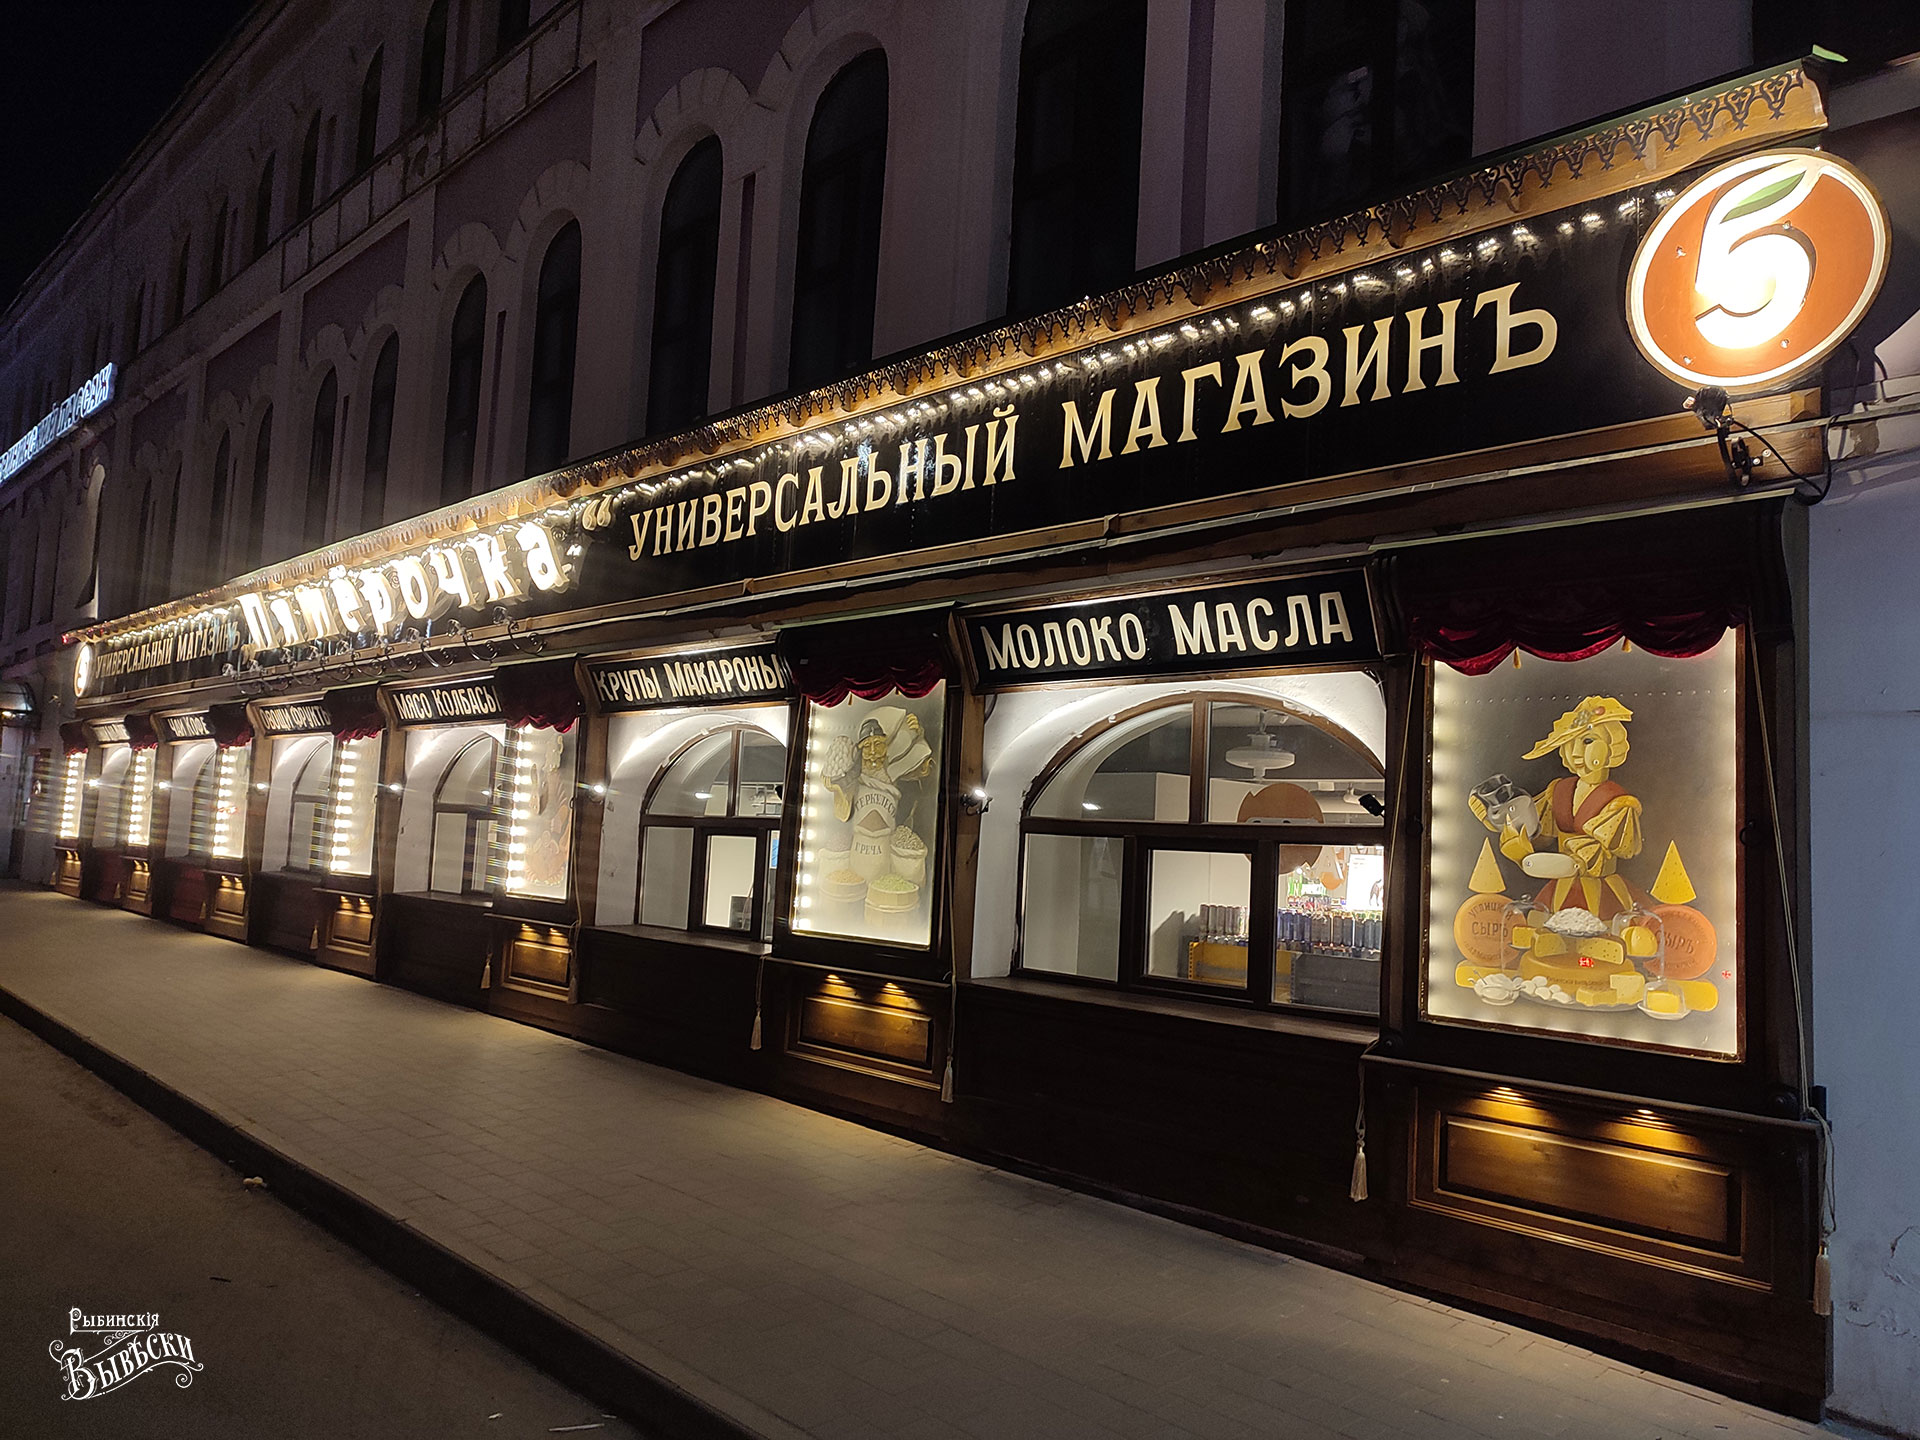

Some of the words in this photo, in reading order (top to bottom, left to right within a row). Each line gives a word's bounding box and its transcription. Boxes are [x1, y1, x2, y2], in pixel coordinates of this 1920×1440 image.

[628, 403, 1020, 561] УНИВЕРСАЛЬНЫЙ
[1058, 281, 1558, 470] МАГАЗИНЪ
[95, 634, 174, 679] УНИВЕРСАЛЬНЫЙ
[175, 621, 242, 662] МАГАЗИНЪ
[980, 612, 1147, 670] МОЛОКО
[1167, 591, 1353, 656] МАСЛА
[393, 692, 432, 720] МЯСО
[431, 685, 502, 716] КОЛБАСЫ
[593, 666, 664, 702] КРУПЫ
[662, 653, 785, 698] МАКАРОНЫ
[1471, 921, 1509, 938] СЫРЪ
